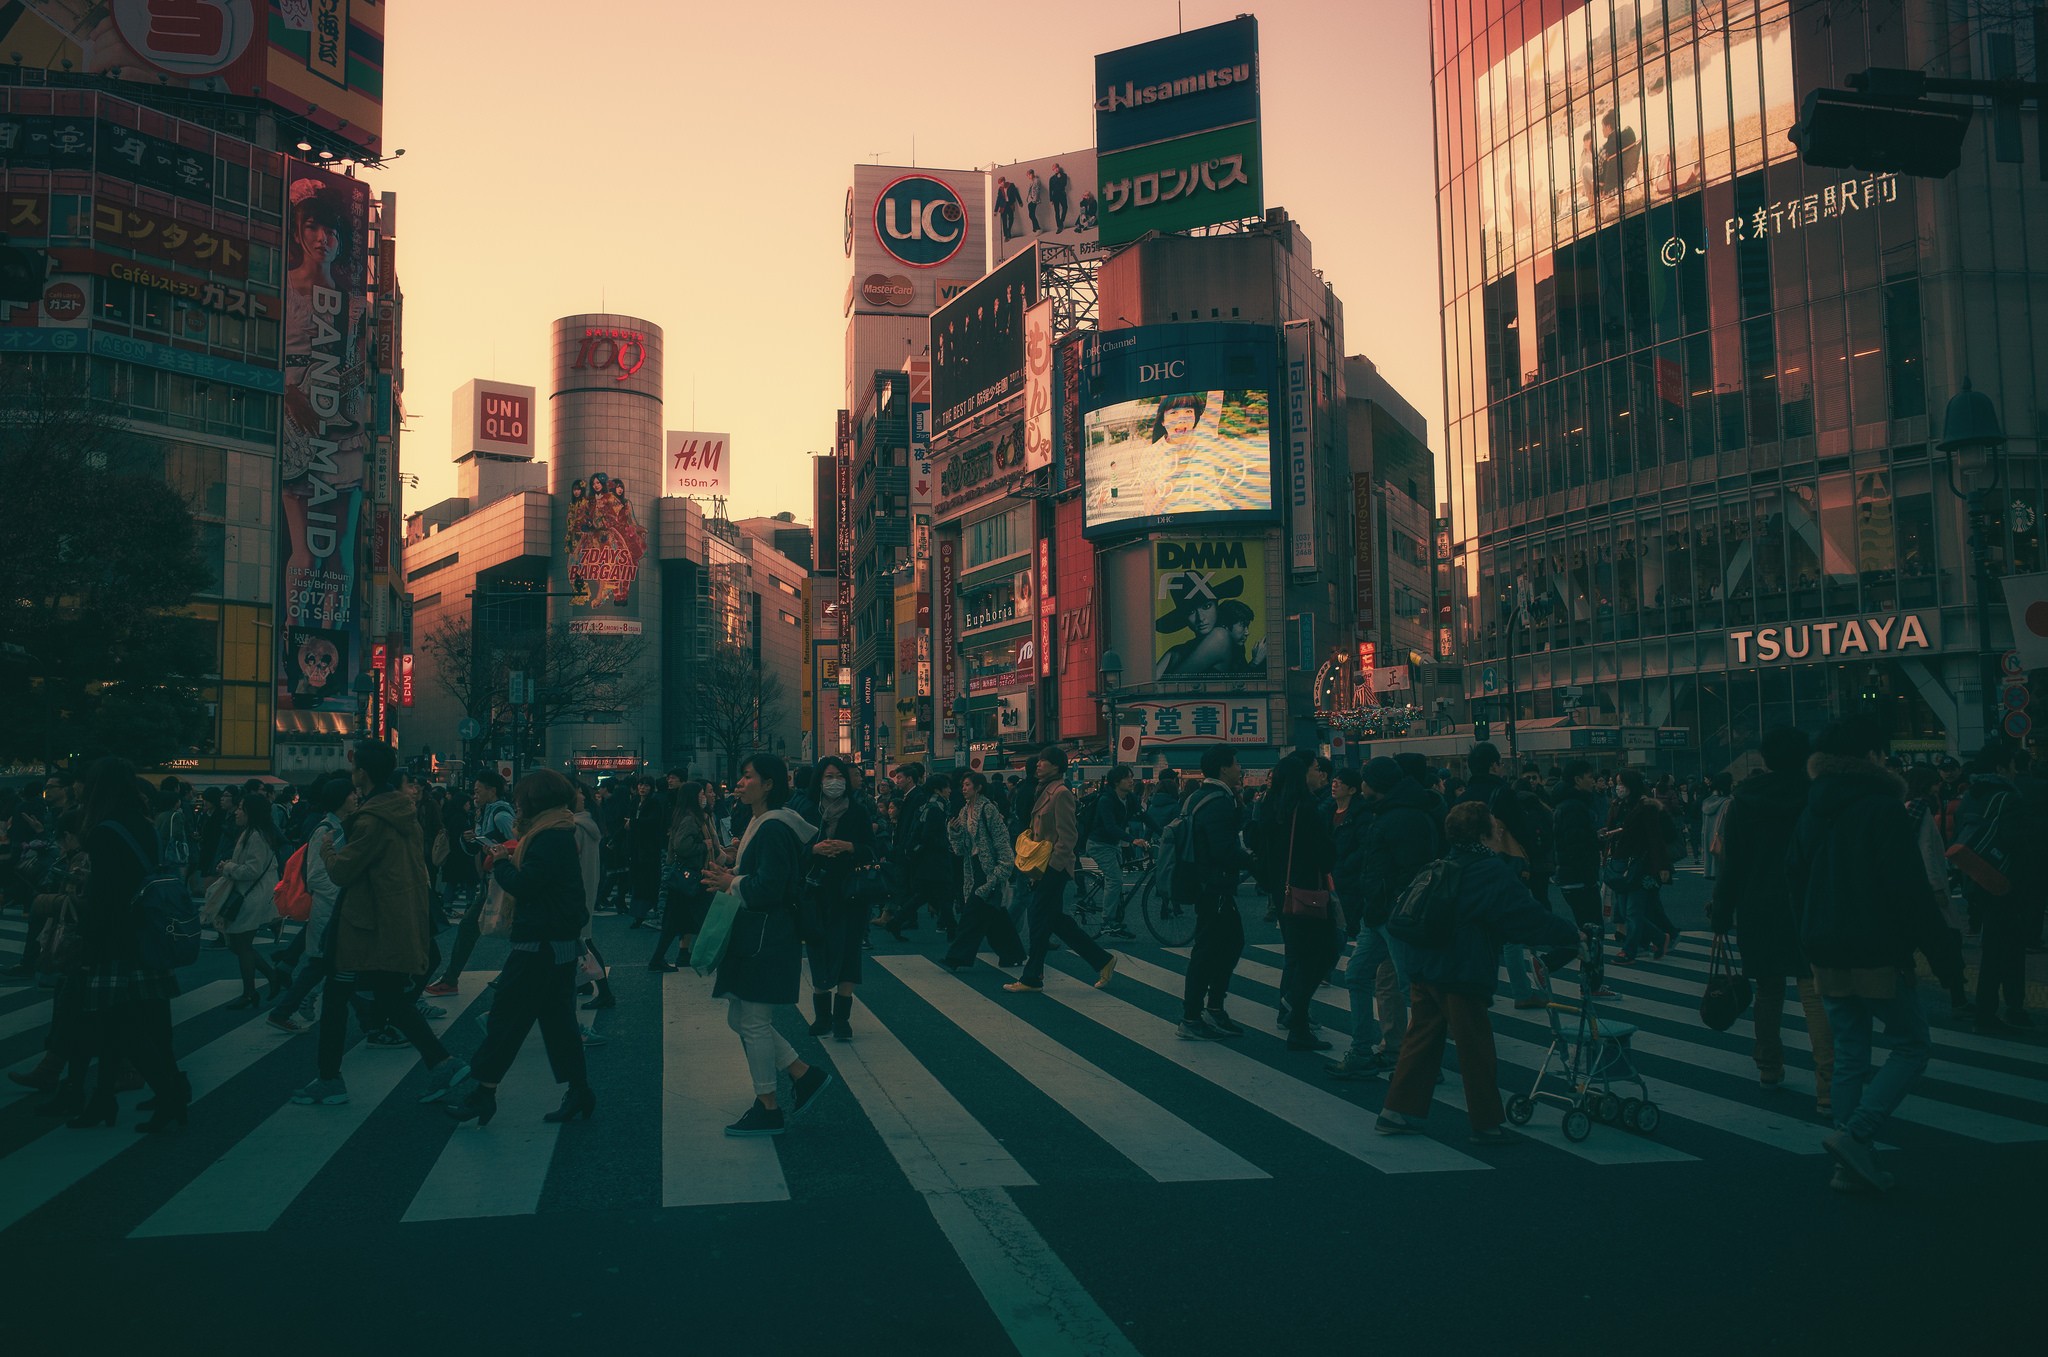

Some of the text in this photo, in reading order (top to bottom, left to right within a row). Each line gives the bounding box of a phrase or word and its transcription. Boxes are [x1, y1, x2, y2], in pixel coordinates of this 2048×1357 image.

[1094, 63, 1249, 113] Hisamitsu
[113, 126, 128, 137] 9F
[1103, 153, 1248, 213] サロンパス
[95, 203, 243, 266] コンタクト
[201, 283, 268, 320] ガスト
[864, 283, 914, 296] MasterCard
[49, 299, 81, 311] ガスト
[52, 332, 75, 349] 6F
[586, 328, 644, 341] SHIBUYA
[102, 336, 147, 362] AEON
[1086, 336, 1137, 359] DHC Channel
[570, 338, 646, 382] 109
[1139, 360, 1185, 384] DHC
[1026, 321, 1051, 462] もんじゃ
[486, 398, 521, 418] UNI
[942, 409, 952, 426] THE
[953, 401, 967, 420] BEST
[967, 396, 975, 412] OF
[308, 285, 342, 558] BAND-MAID
[486, 418, 524, 438] QLO
[674, 440, 723, 472] H&M
[914, 448, 925, 461] 夜
[679, 478, 708, 488] 150m
[1293, 441, 1307, 507] neon
[580, 548, 629, 564] 7DAYS
[1157, 542, 1248, 570] DMM
[289, 567, 350, 581] 1st Full Album
[569, 565, 637, 581] BARGAIN
[1158, 571, 1217, 600] FX
[1358, 568, 1373, 623] 三千里
[289, 589, 350, 609] 2017.1.11
[289, 605, 350, 623] On Sale!!
[966, 604, 1013, 629] Euphoria
[1730, 615, 1929, 663] TSUTAYA
[1018, 640, 1034, 664] JTB
[403, 675, 411, 697] アコム
